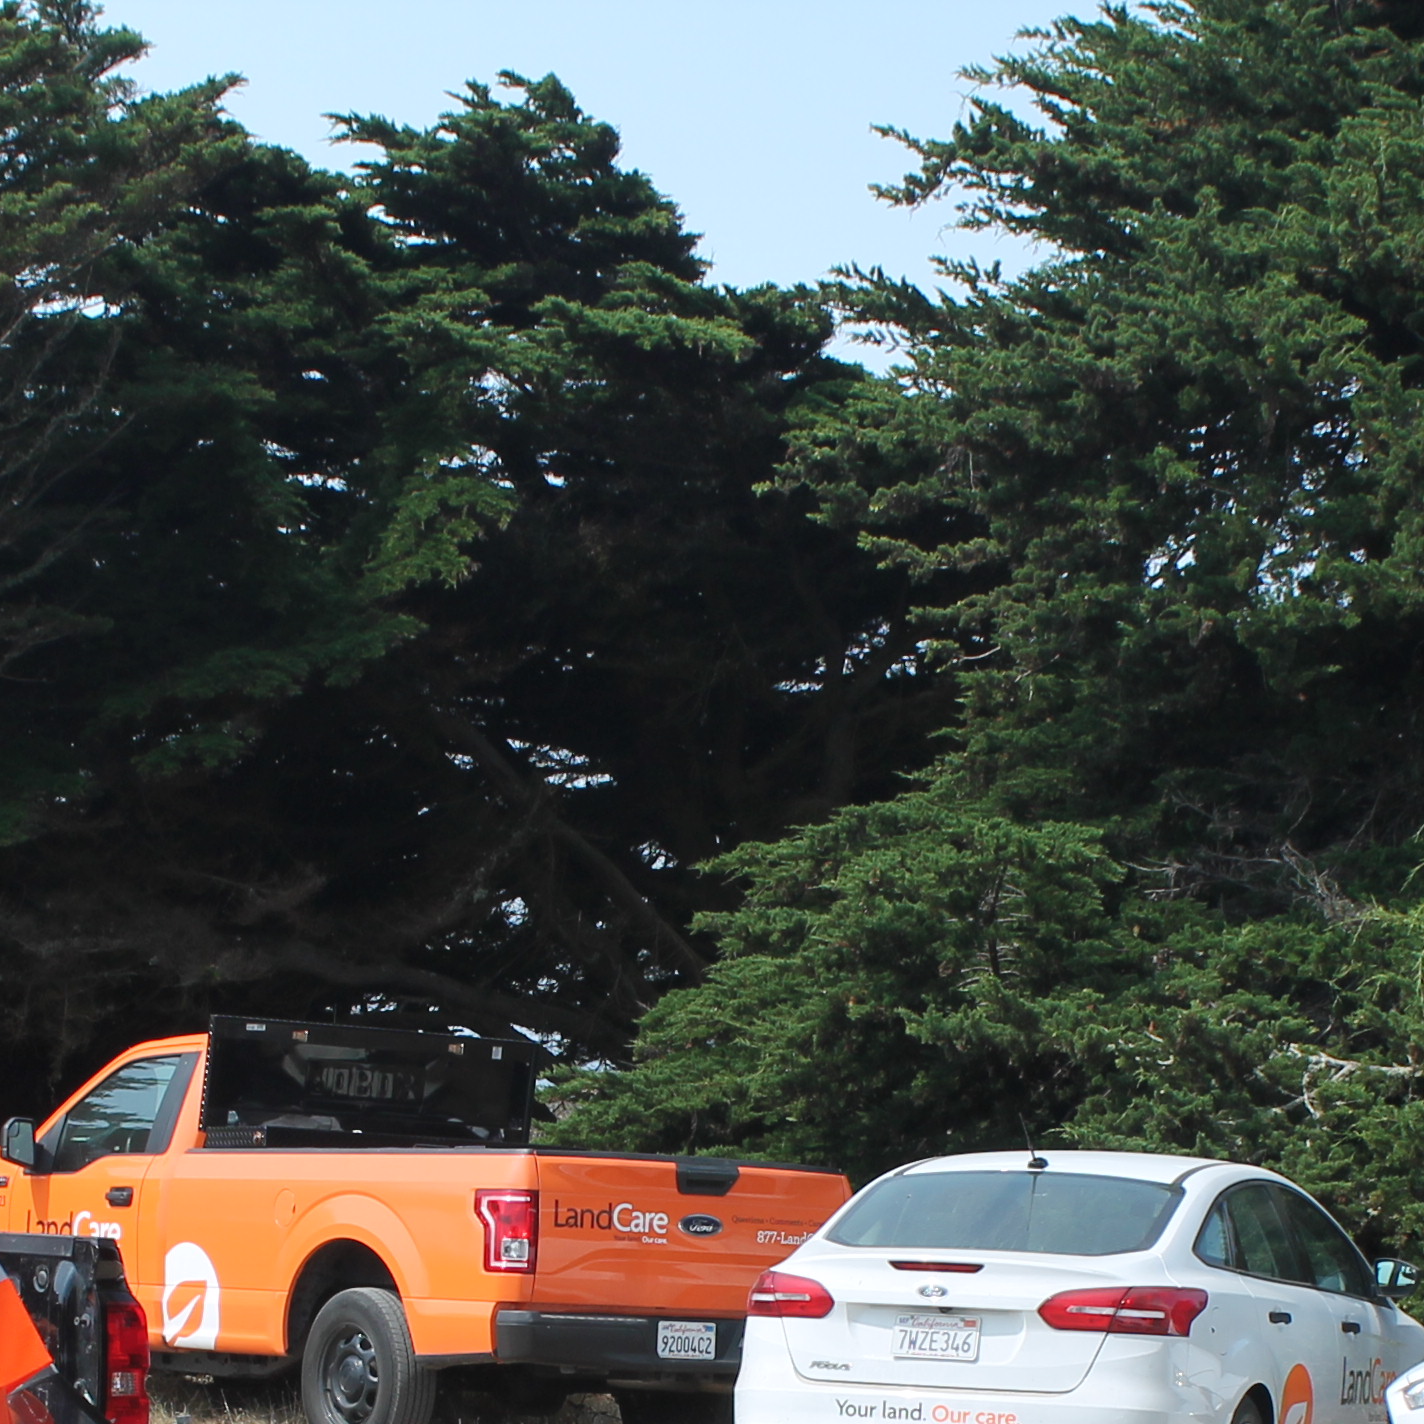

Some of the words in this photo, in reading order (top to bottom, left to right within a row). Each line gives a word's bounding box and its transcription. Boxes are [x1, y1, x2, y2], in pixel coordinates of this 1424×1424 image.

[554, 1199, 669, 1234] LandCare
[911, 1316, 961, 1329] California
[661, 1335, 713, 1355] 92004C2
[899, 1328, 974, 1354] 7WZE346
[835, 1398, 877, 1417] Your
[882, 1400, 927, 1422] land.
[932, 1405, 971, 1423] Our
